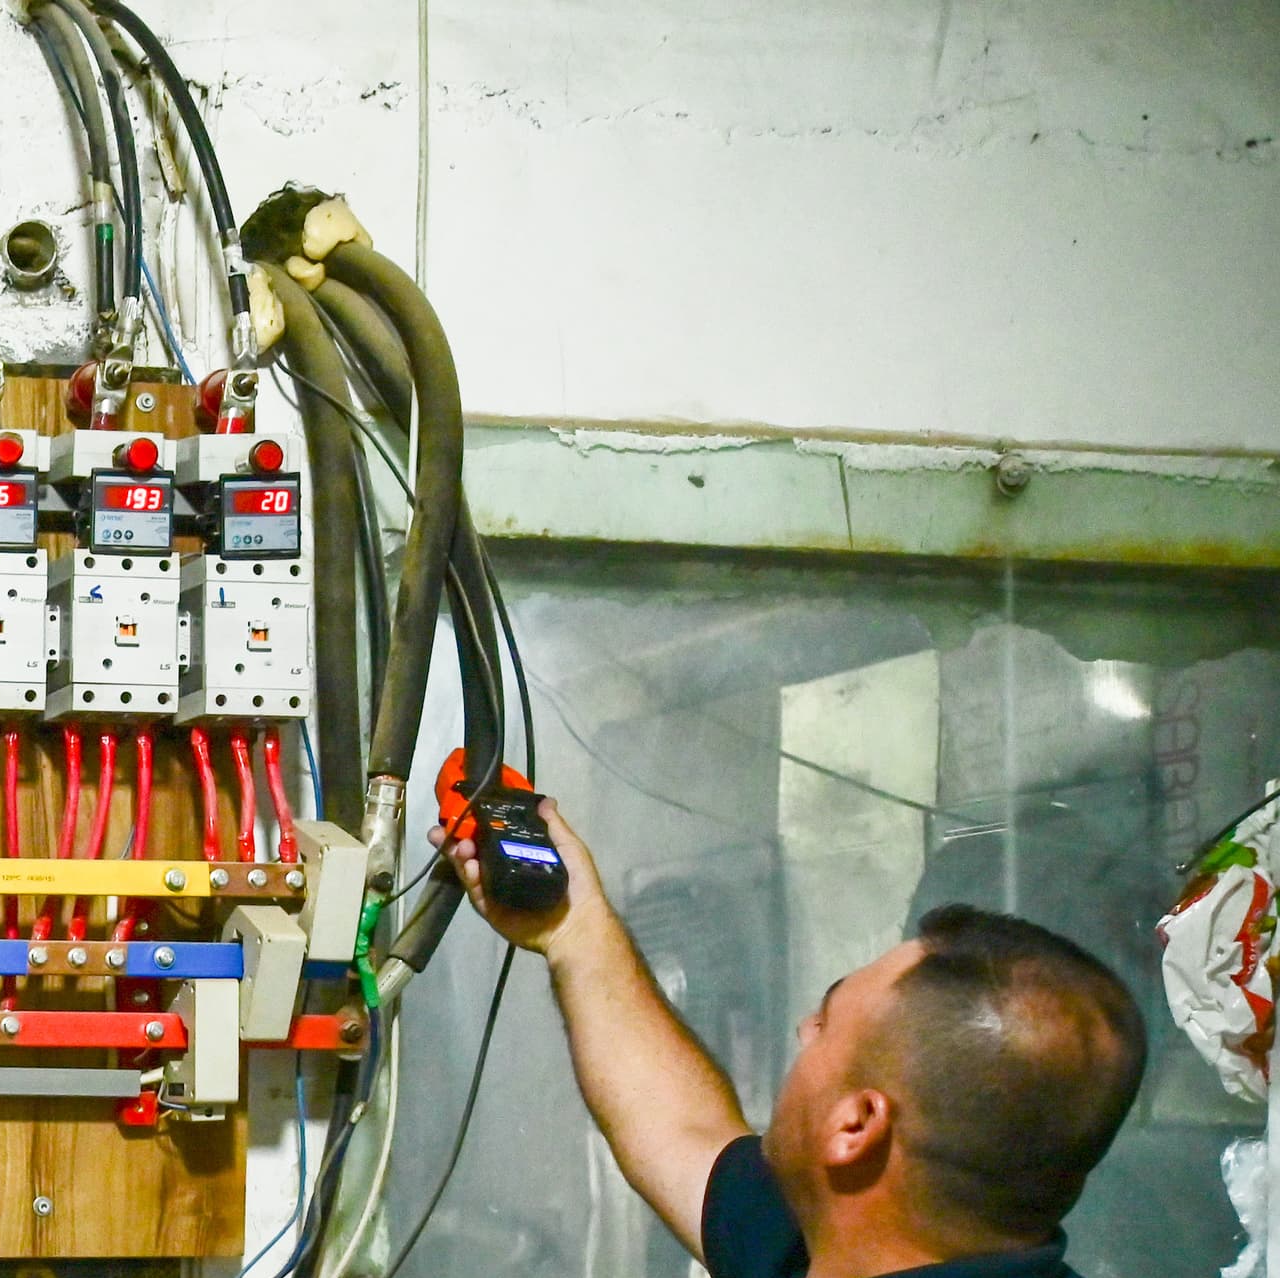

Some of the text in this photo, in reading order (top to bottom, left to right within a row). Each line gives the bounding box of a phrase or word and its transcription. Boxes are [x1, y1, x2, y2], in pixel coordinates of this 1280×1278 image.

[126, 487, 161, 510] 193
[261, 491, 289, 512] 20
[159, 663, 171, 671] LS
[290, 667, 302, 675] LS
